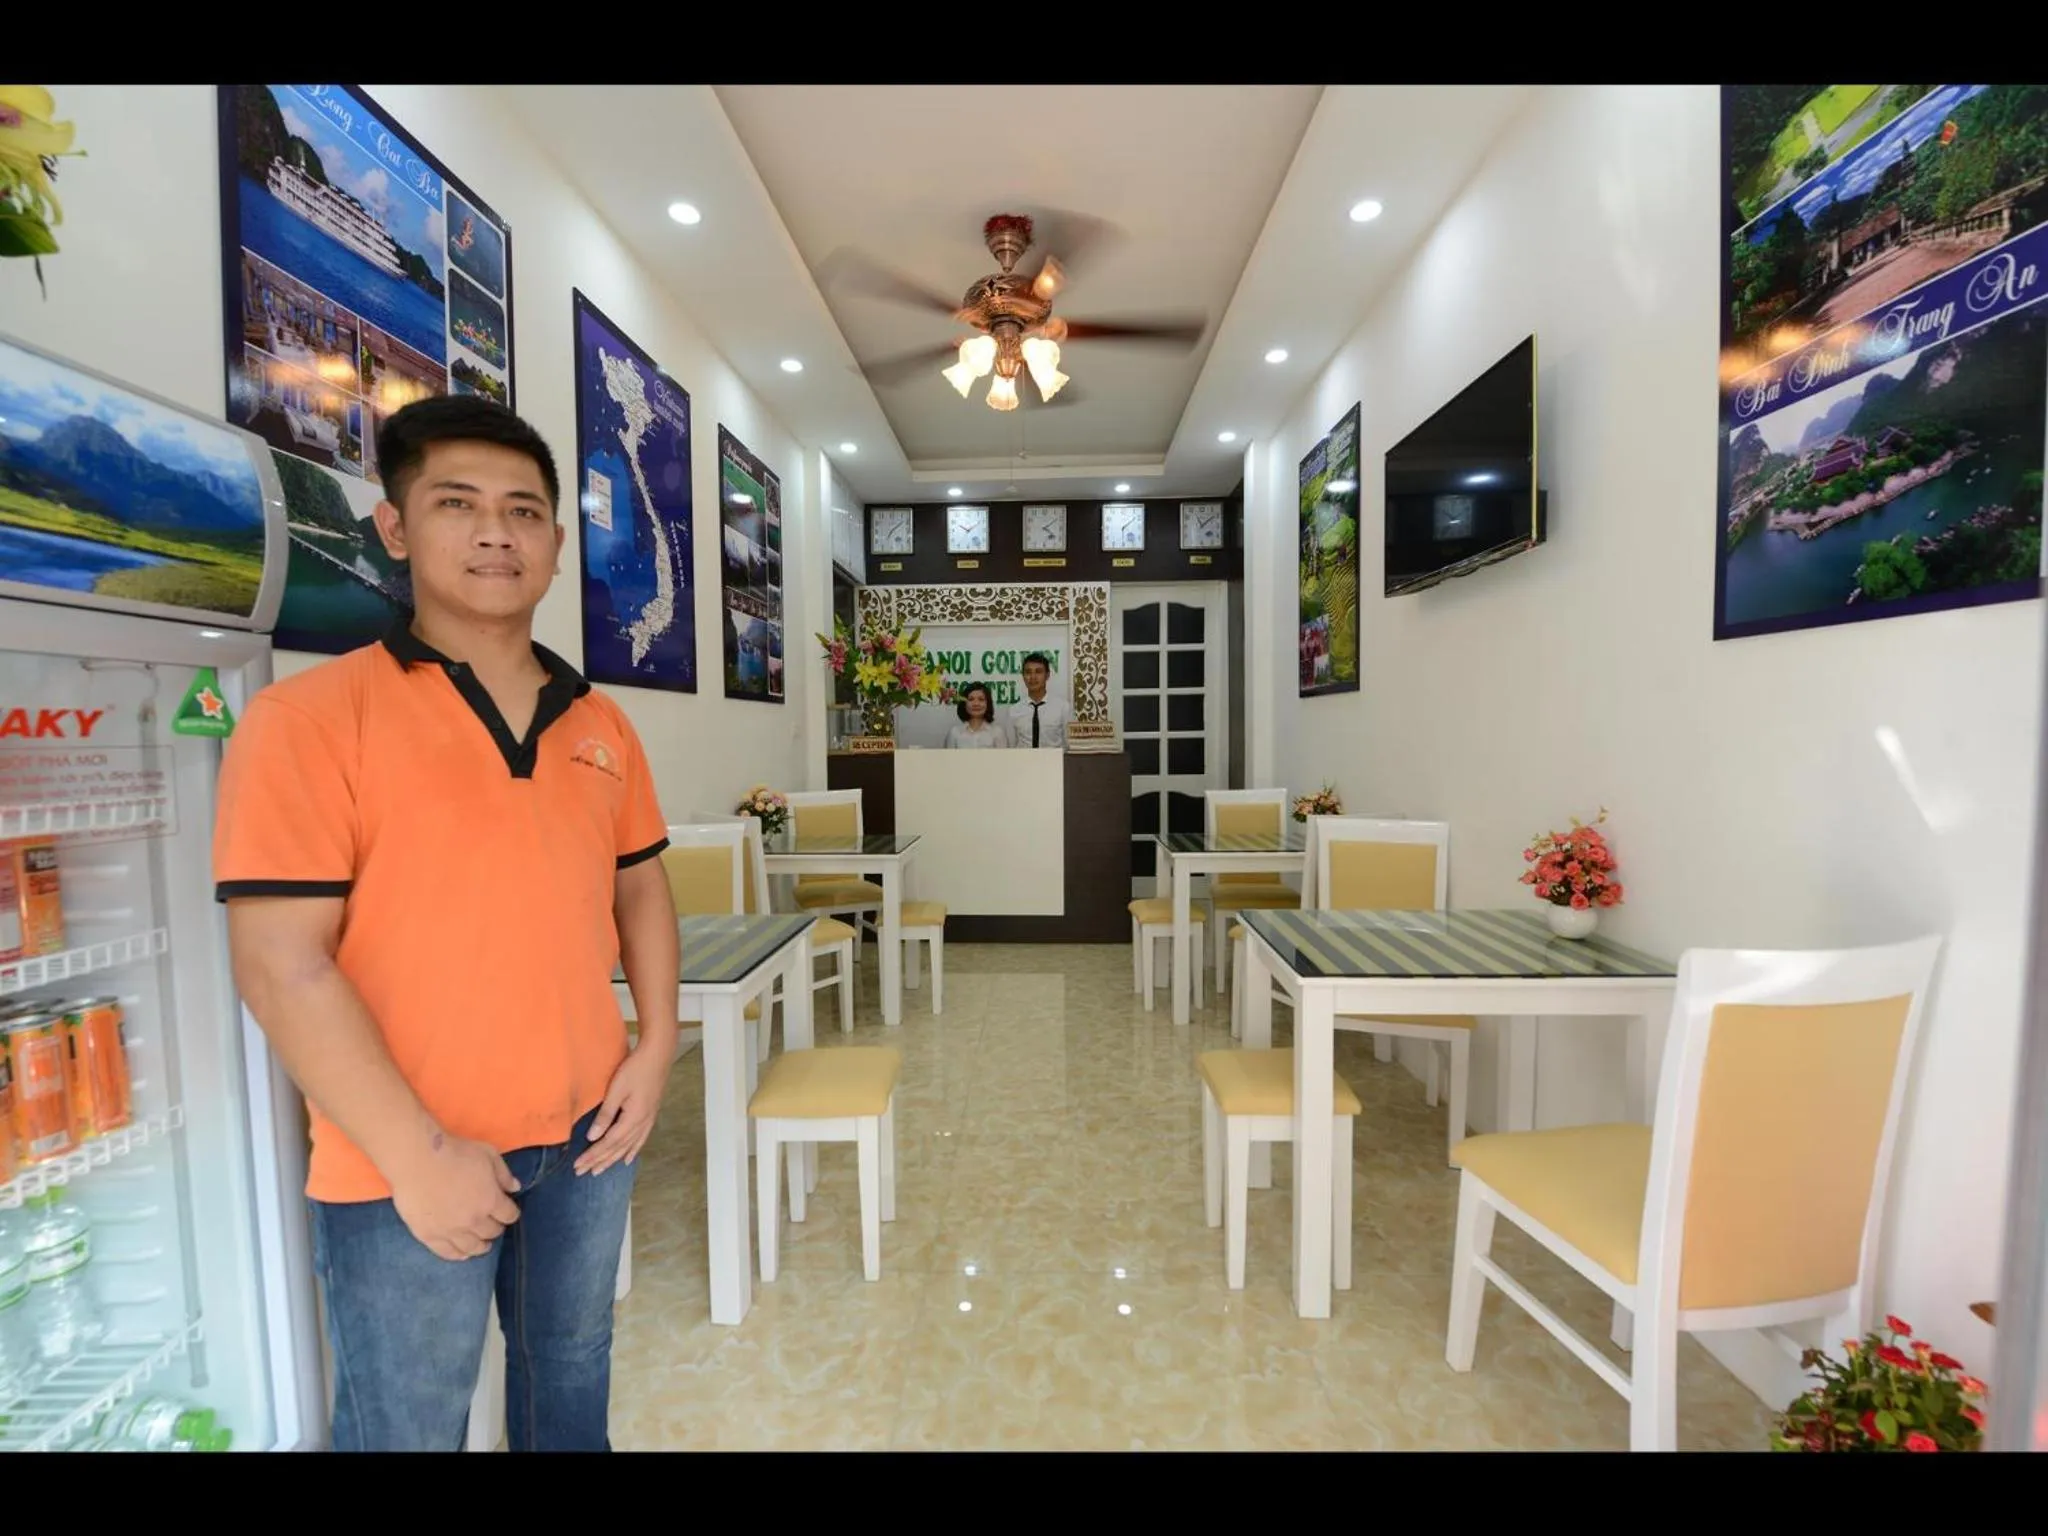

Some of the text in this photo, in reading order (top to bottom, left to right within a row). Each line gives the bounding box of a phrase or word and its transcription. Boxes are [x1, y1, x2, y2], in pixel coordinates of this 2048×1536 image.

[1871, 295, 1956, 354] Trang
[1966, 253, 2040, 313] An
[924, 650, 972, 675] ANOI
